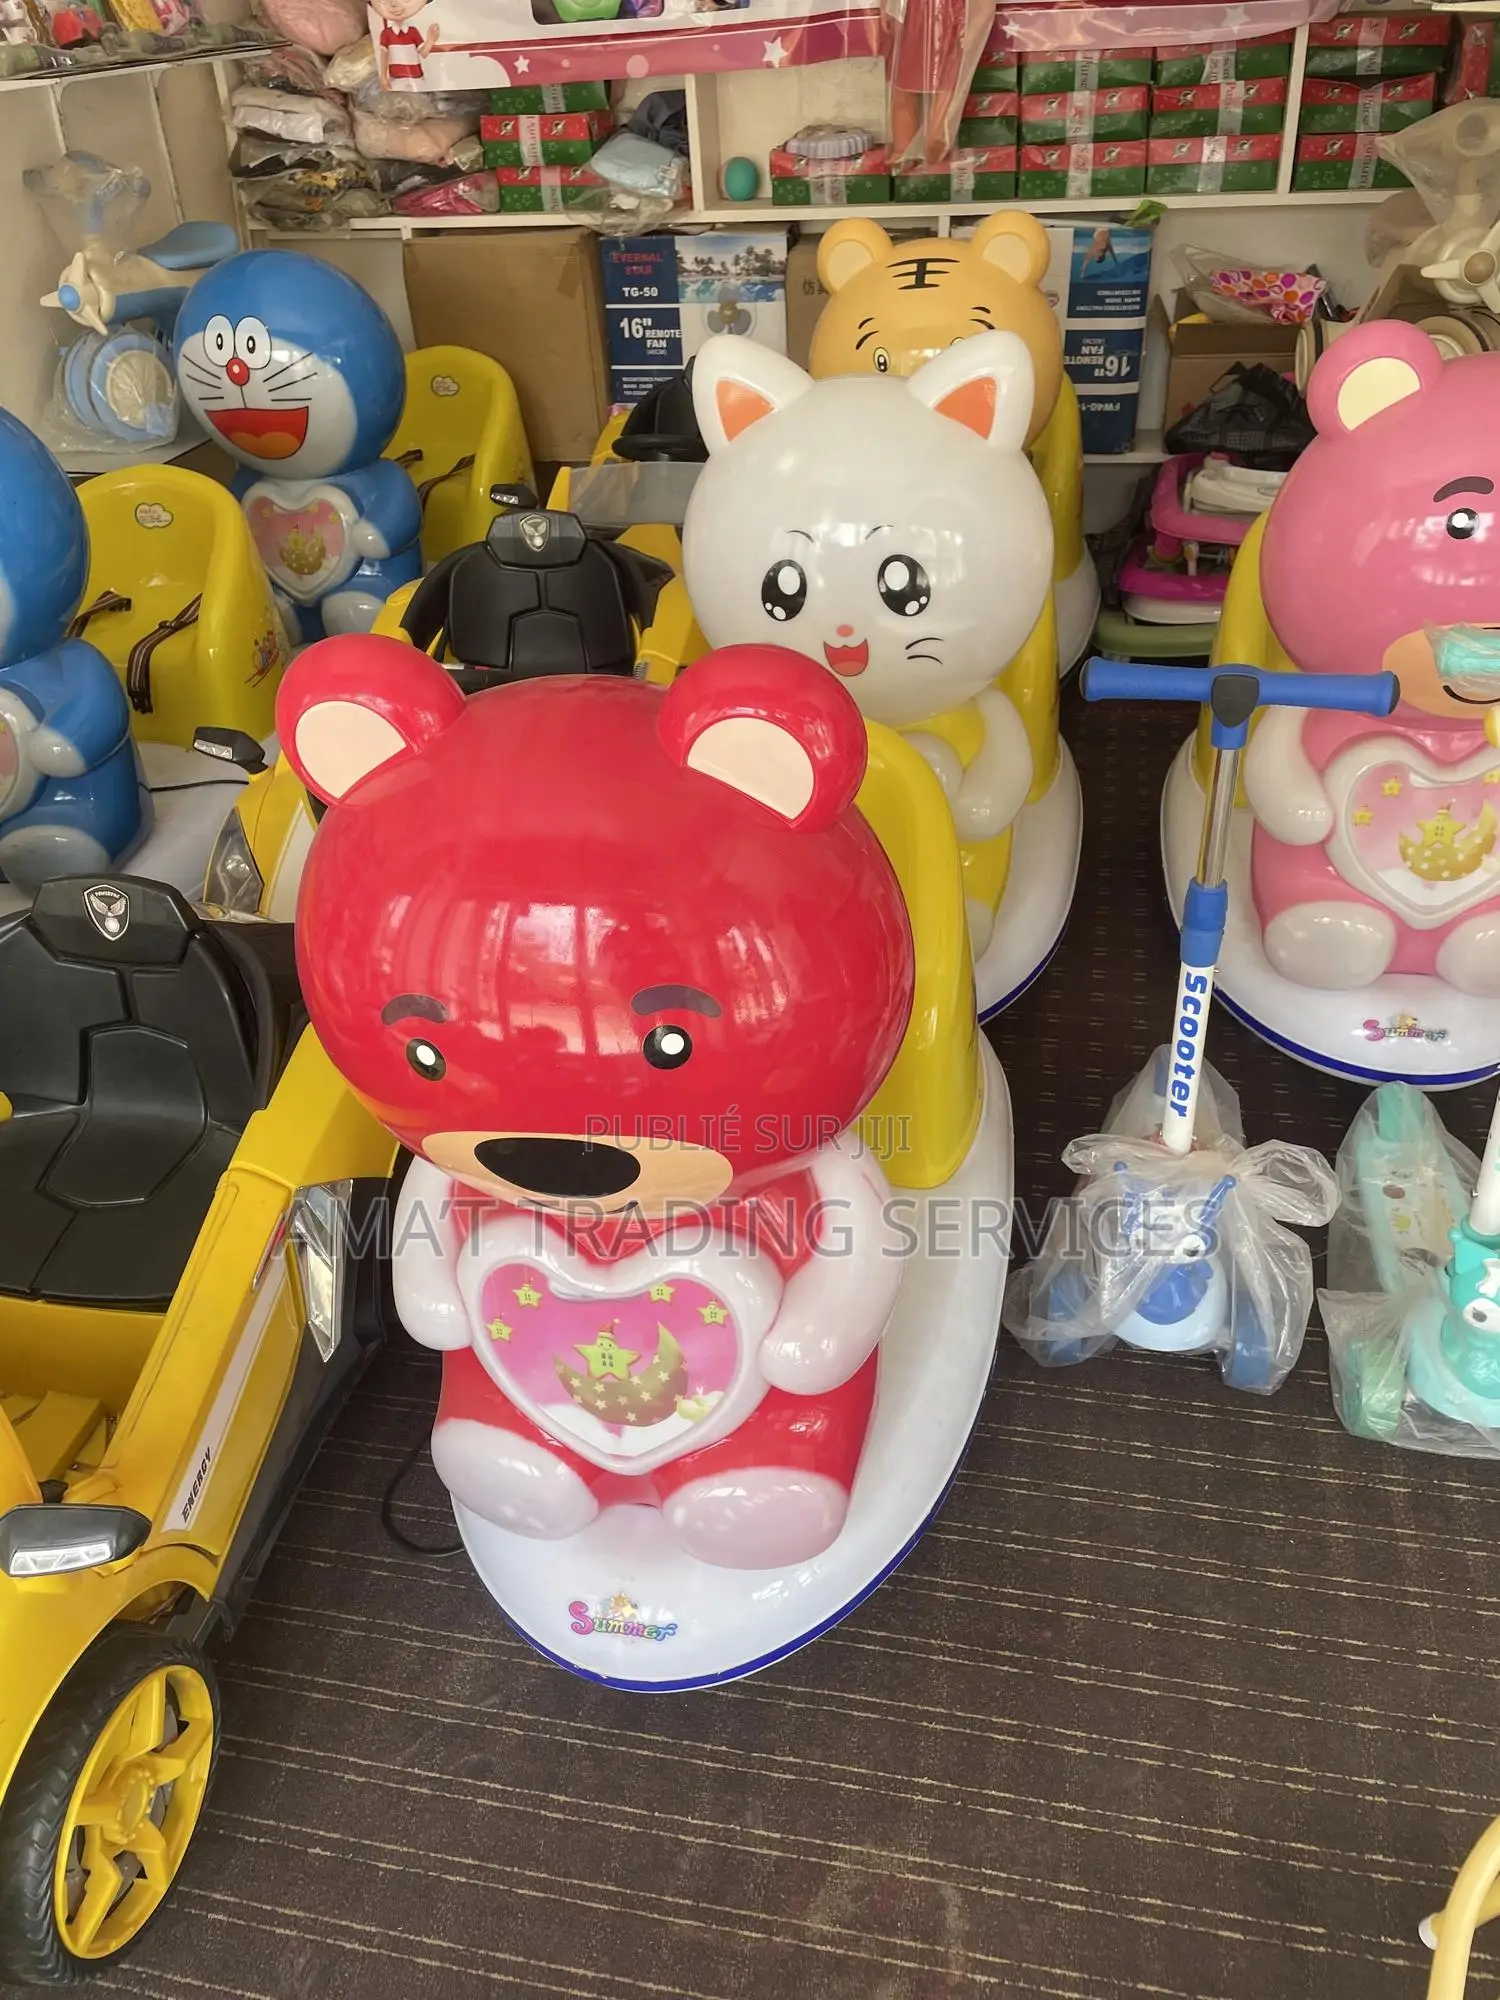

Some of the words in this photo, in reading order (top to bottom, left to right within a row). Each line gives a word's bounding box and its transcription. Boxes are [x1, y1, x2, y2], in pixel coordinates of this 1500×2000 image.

[624, 264, 653, 276] STAR
[622, 286, 659, 297] TG-50
[619, 317, 652, 339] 16"
[644, 329, 682, 338] REMOTE
[646, 339, 667, 348] FAN
[1081, 345, 1104, 355] FAN
[1063, 356, 1104, 365] REMOTE
[1170, 971, 1208, 1118] Scooter
[181, 1445, 211, 1524] ENERGY
[568, 1600, 678, 1642] Summer
